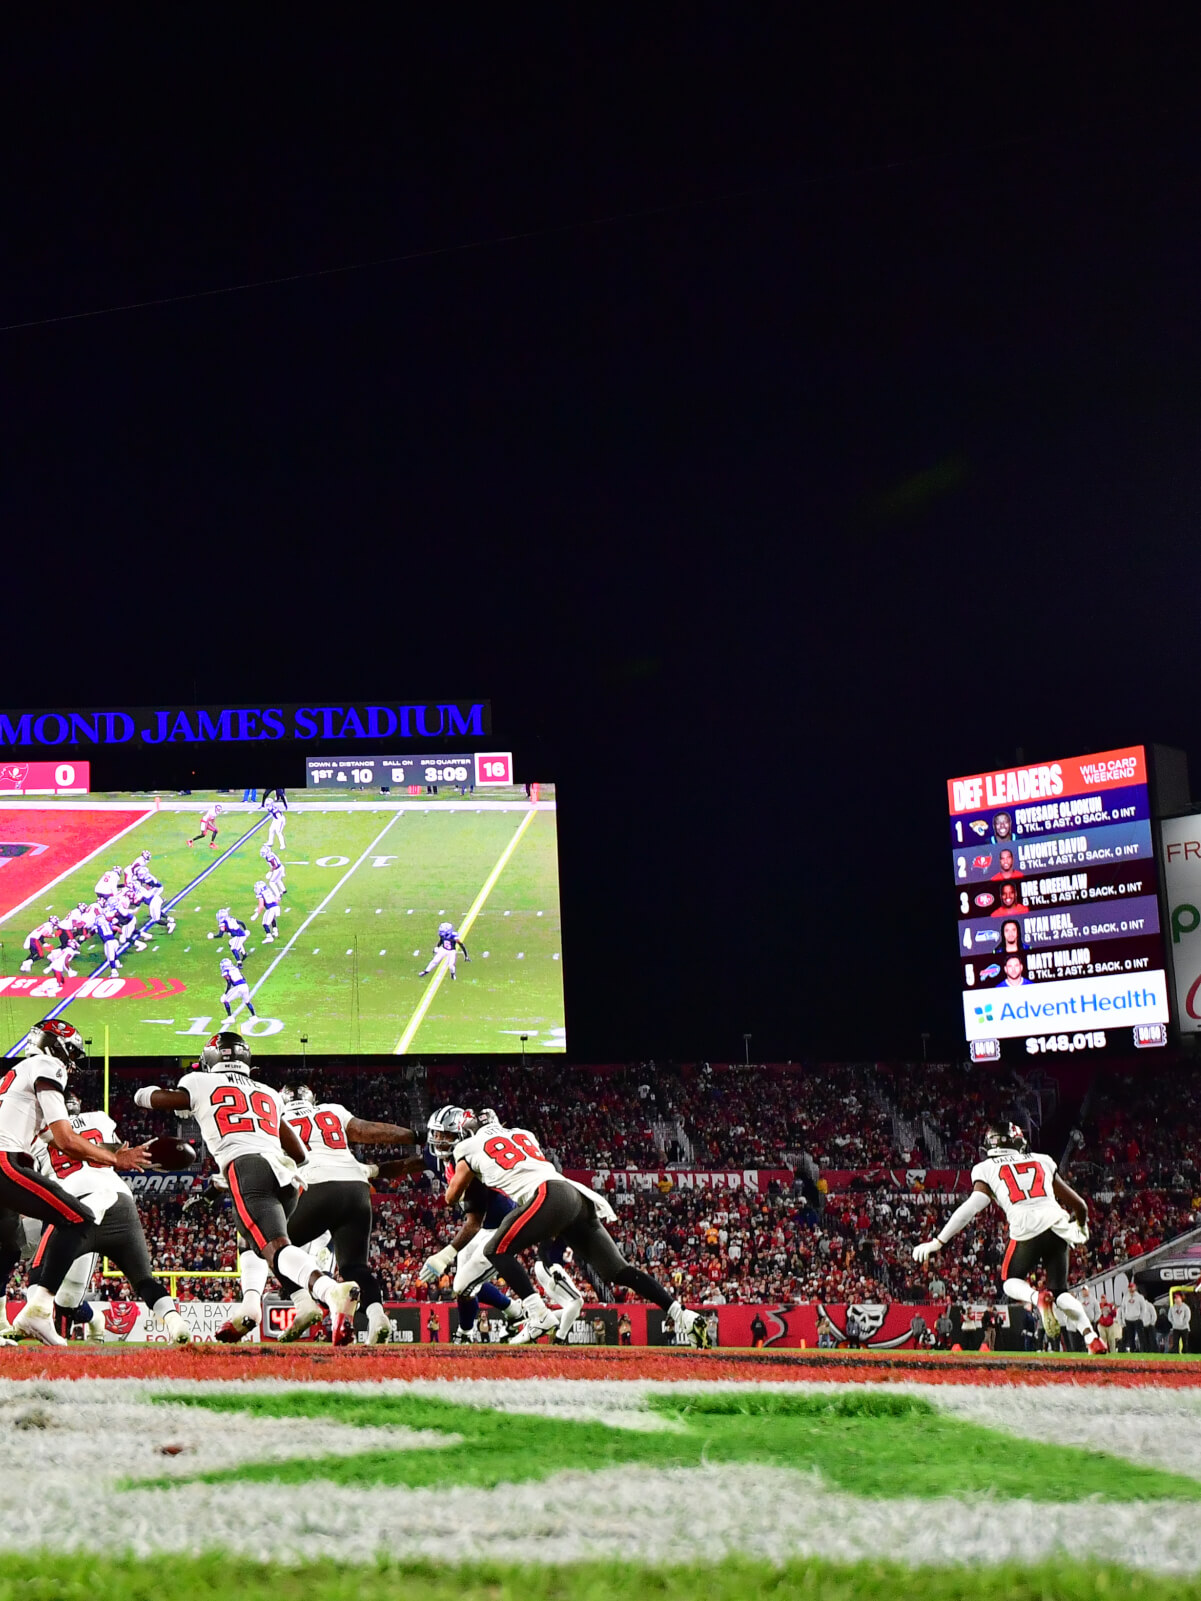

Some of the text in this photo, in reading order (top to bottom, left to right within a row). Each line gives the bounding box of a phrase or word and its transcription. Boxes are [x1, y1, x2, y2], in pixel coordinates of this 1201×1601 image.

[141, 708, 286, 743] JAMES
[294, 704, 485, 740] STADIUM
[55, 764, 75, 786] 0
[311, 768, 373, 784] 1ST & 10
[391, 768, 405, 783] 5
[424, 766, 468, 782] 3:09
[483, 762, 505, 778] 16
[1080, 757, 1137, 775] WILD CARD
[1084, 768, 1135, 785] WEEKEND
[953, 764, 1063, 812] DEF LEADERS
[1053, 817, 1074, 829] AST,
[1083, 811, 1110, 824] SACK,
[1112, 810, 1119, 819] 0
[1120, 806, 1136, 817] INT
[955, 821, 964, 843] 1
[1018, 836, 1087, 861] LAVONTE DAVID
[1048, 856, 1054, 866] 4
[1055, 853, 1076, 865] AST,
[1086, 848, 1114, 861] SACK,
[1115, 847, 1122, 856] 0
[1123, 844, 1139, 855] INT
[957, 857, 967, 878] 2
[1021, 873, 1088, 898] DRE GREENLAW
[1059, 891, 1079, 902] AST,
[1089, 886, 1117, 897] SACK,
[1118, 884, 1125, 893] 0
[1126, 881, 1142, 892] INT
[1050, 913, 1073, 930] NEAL
[1053, 930, 1060, 939] 2
[1061, 927, 1081, 938] AST,
[1091, 922, 1119, 933] SACK,
[1120, 922, 1127, 930] 0
[1128, 919, 1144, 929] INT
[962, 928, 972, 949] 4
[1026, 947, 1090, 971] MATT MILANO
[1057, 967, 1064, 976] 2
[1065, 964, 1086, 976] AST,
[1095, 960, 1123, 972] SACK,
[1124, 960, 1131, 969] 0
[1133, 957, 1149, 968] INT
[75, 977, 126, 999] 10
[1025, 1031, 1106, 1054] $148,015
[225, 1073, 260, 1089] WHITE
[211, 1086, 279, 1138] 29
[288, 1110, 347, 1151] 78
[483, 1133, 546, 1170] 88
[999, 1161, 1047, 1205] 17
[204, 1305, 232, 1318] BAY
[393, 1331, 413, 1342] CLUB
